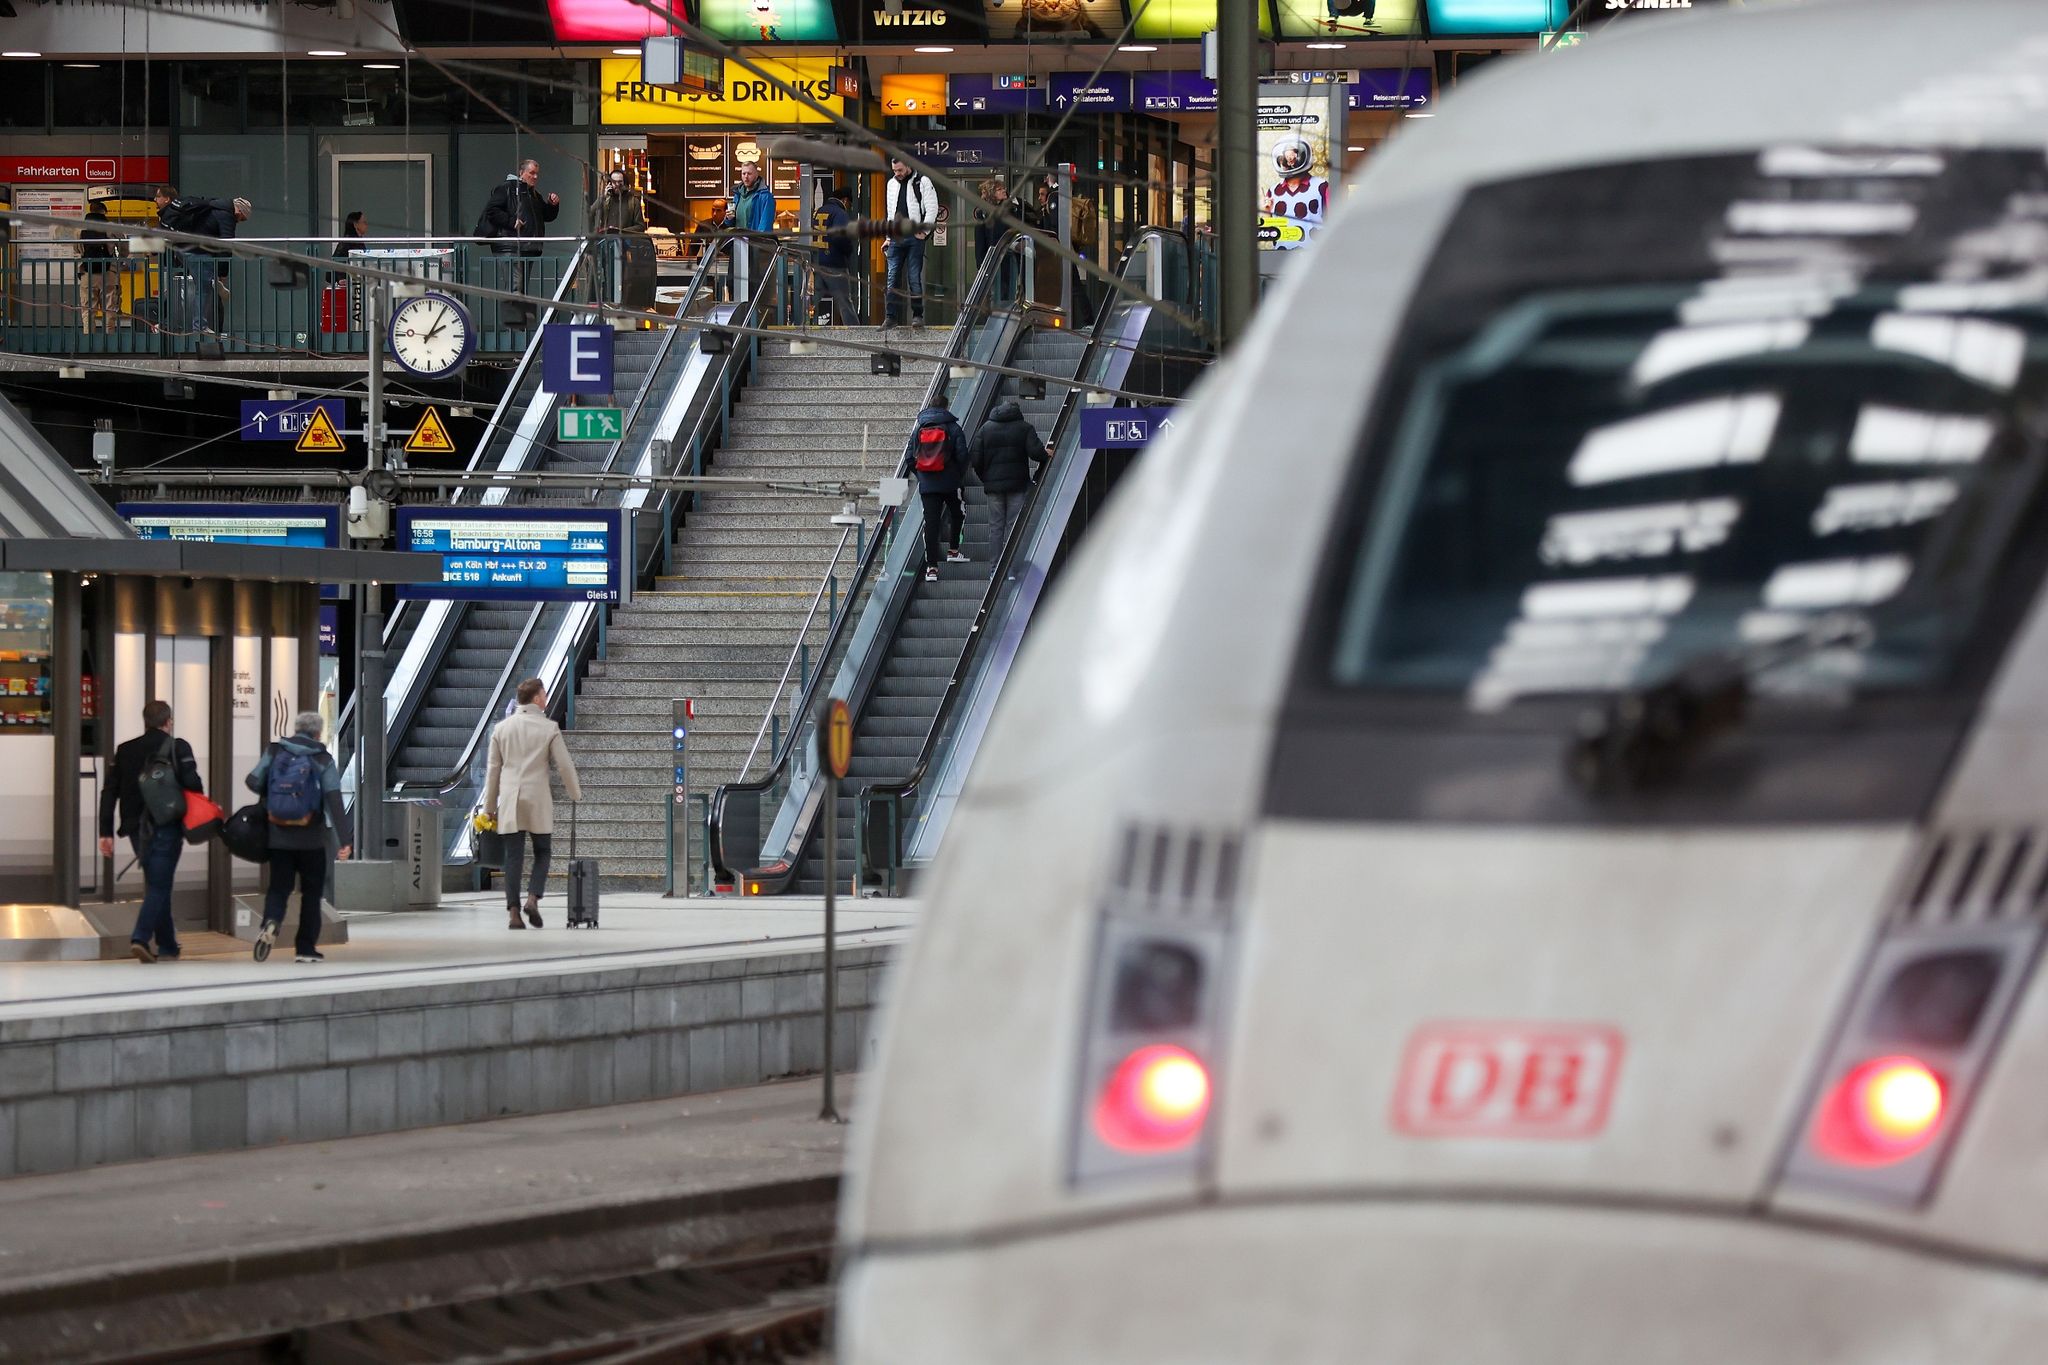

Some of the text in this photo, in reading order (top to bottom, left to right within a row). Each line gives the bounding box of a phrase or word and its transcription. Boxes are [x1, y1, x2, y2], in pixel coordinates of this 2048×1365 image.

[873, 9, 947, 26] WITZIG
[1000, 76, 1009, 87] U
[732, 80, 831, 102] DRINKS
[1072, 87, 1110, 95] Kircenallee
[1373, 94, 1411, 102] Reisezentum
[1273, 106, 1289, 114] dich
[1288, 116, 1302, 124] und
[914, 141, 950, 156] 11-12
[17, 166, 80, 176] Fahrkarten
[352, 277, 362, 323] Abfal
[570, 331, 601, 381] E
[412, 530, 434, 538] 16:58
[450, 538, 542, 553] Hamburg-Altona
[465, 560, 483, 569] Köln
[485, 560, 499, 569] Hbf
[518, 561, 534, 570] FLX
[537, 561, 547, 570] 20
[450, 572, 523, 582] ICE 518 Ankunft
[586, 590, 618, 600] Gleis 11
[413, 833, 422, 890] Abfall
[1428, 1040, 1582, 1120] DB
